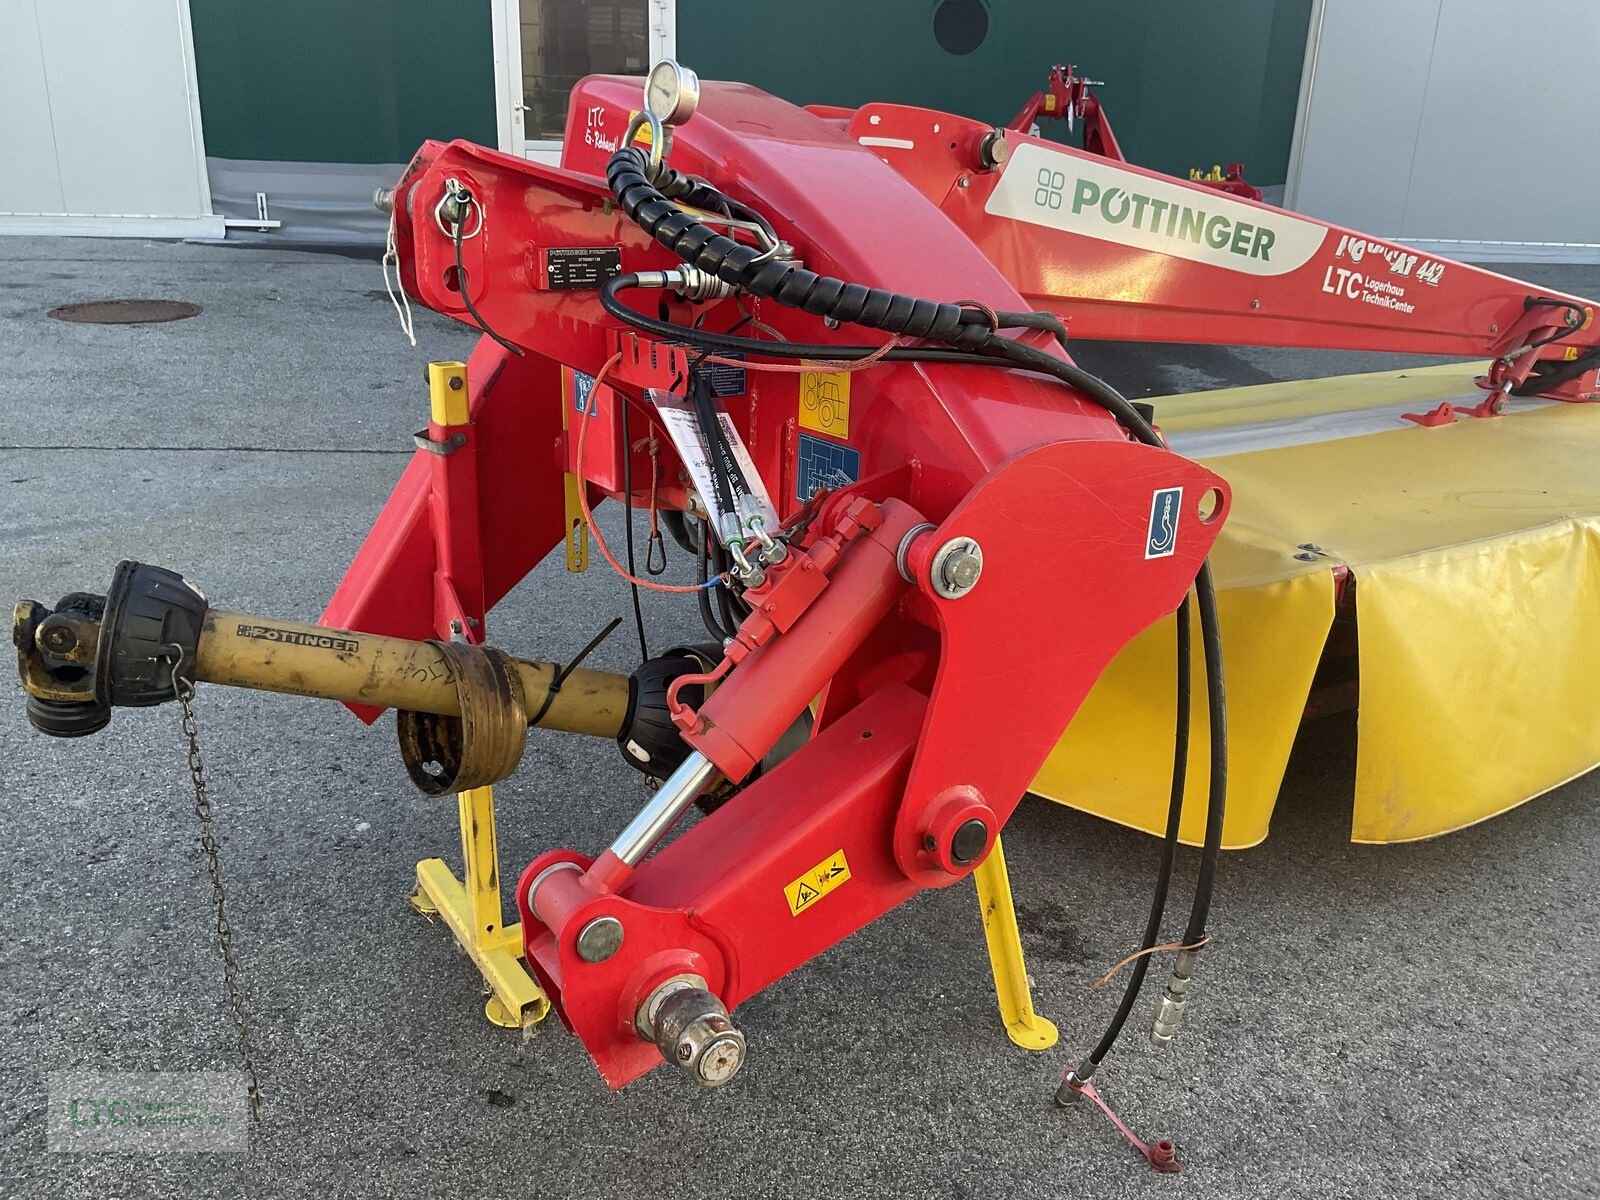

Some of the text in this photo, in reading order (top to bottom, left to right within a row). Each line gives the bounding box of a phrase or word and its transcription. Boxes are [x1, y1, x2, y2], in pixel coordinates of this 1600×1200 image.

[588, 106, 605, 127] LTC
[1071, 178, 1276, 262] PÖTTINGER
[1322, 265, 1363, 299] LTC
[1416, 259, 1445, 286] 442
[1364, 275, 1405, 297] Lagerhaus
[1362, 290, 1415, 314] TechnikCenter
[251, 626, 358, 652] PÖTTINGER
